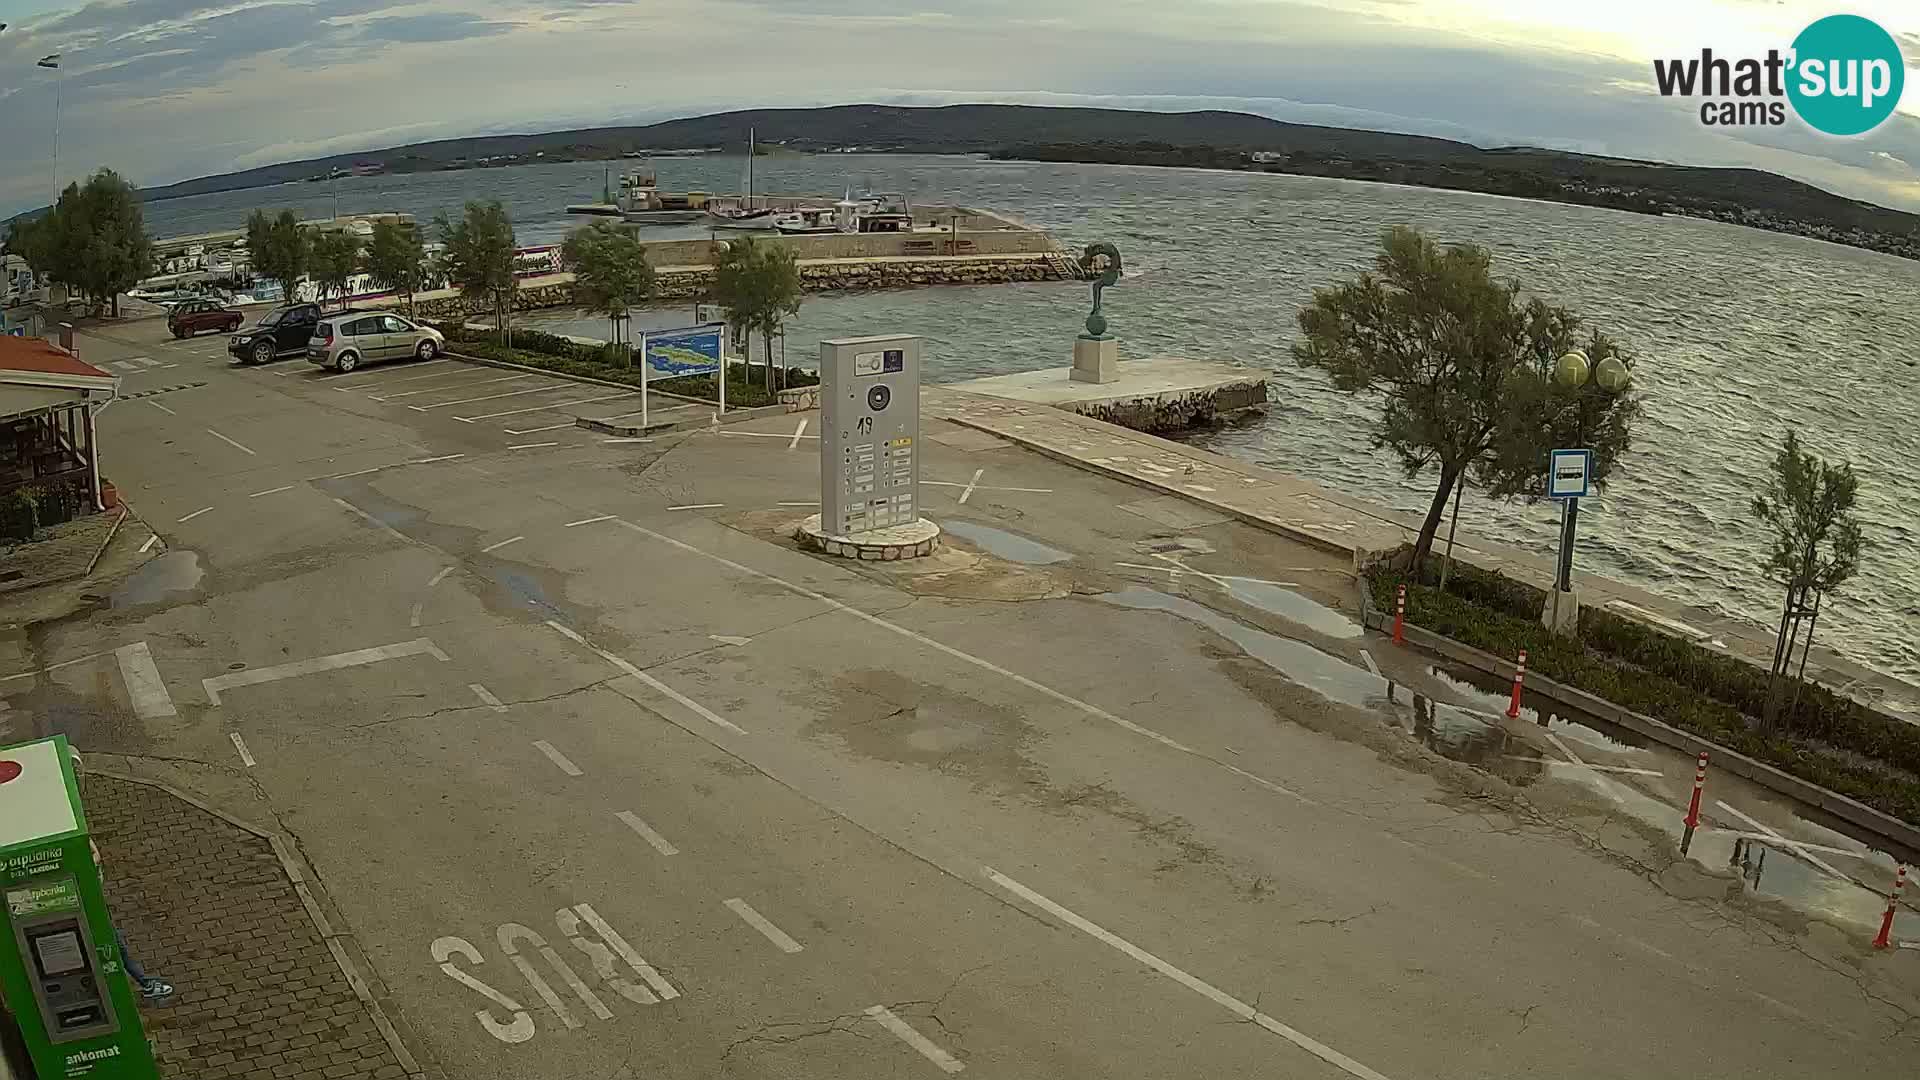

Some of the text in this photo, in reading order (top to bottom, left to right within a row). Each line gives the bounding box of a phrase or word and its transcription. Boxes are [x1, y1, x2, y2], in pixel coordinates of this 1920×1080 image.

[856, 416, 873, 436] 19
[431, 903, 681, 1043] BUS
[65, 1045, 121, 1065] ankomat
